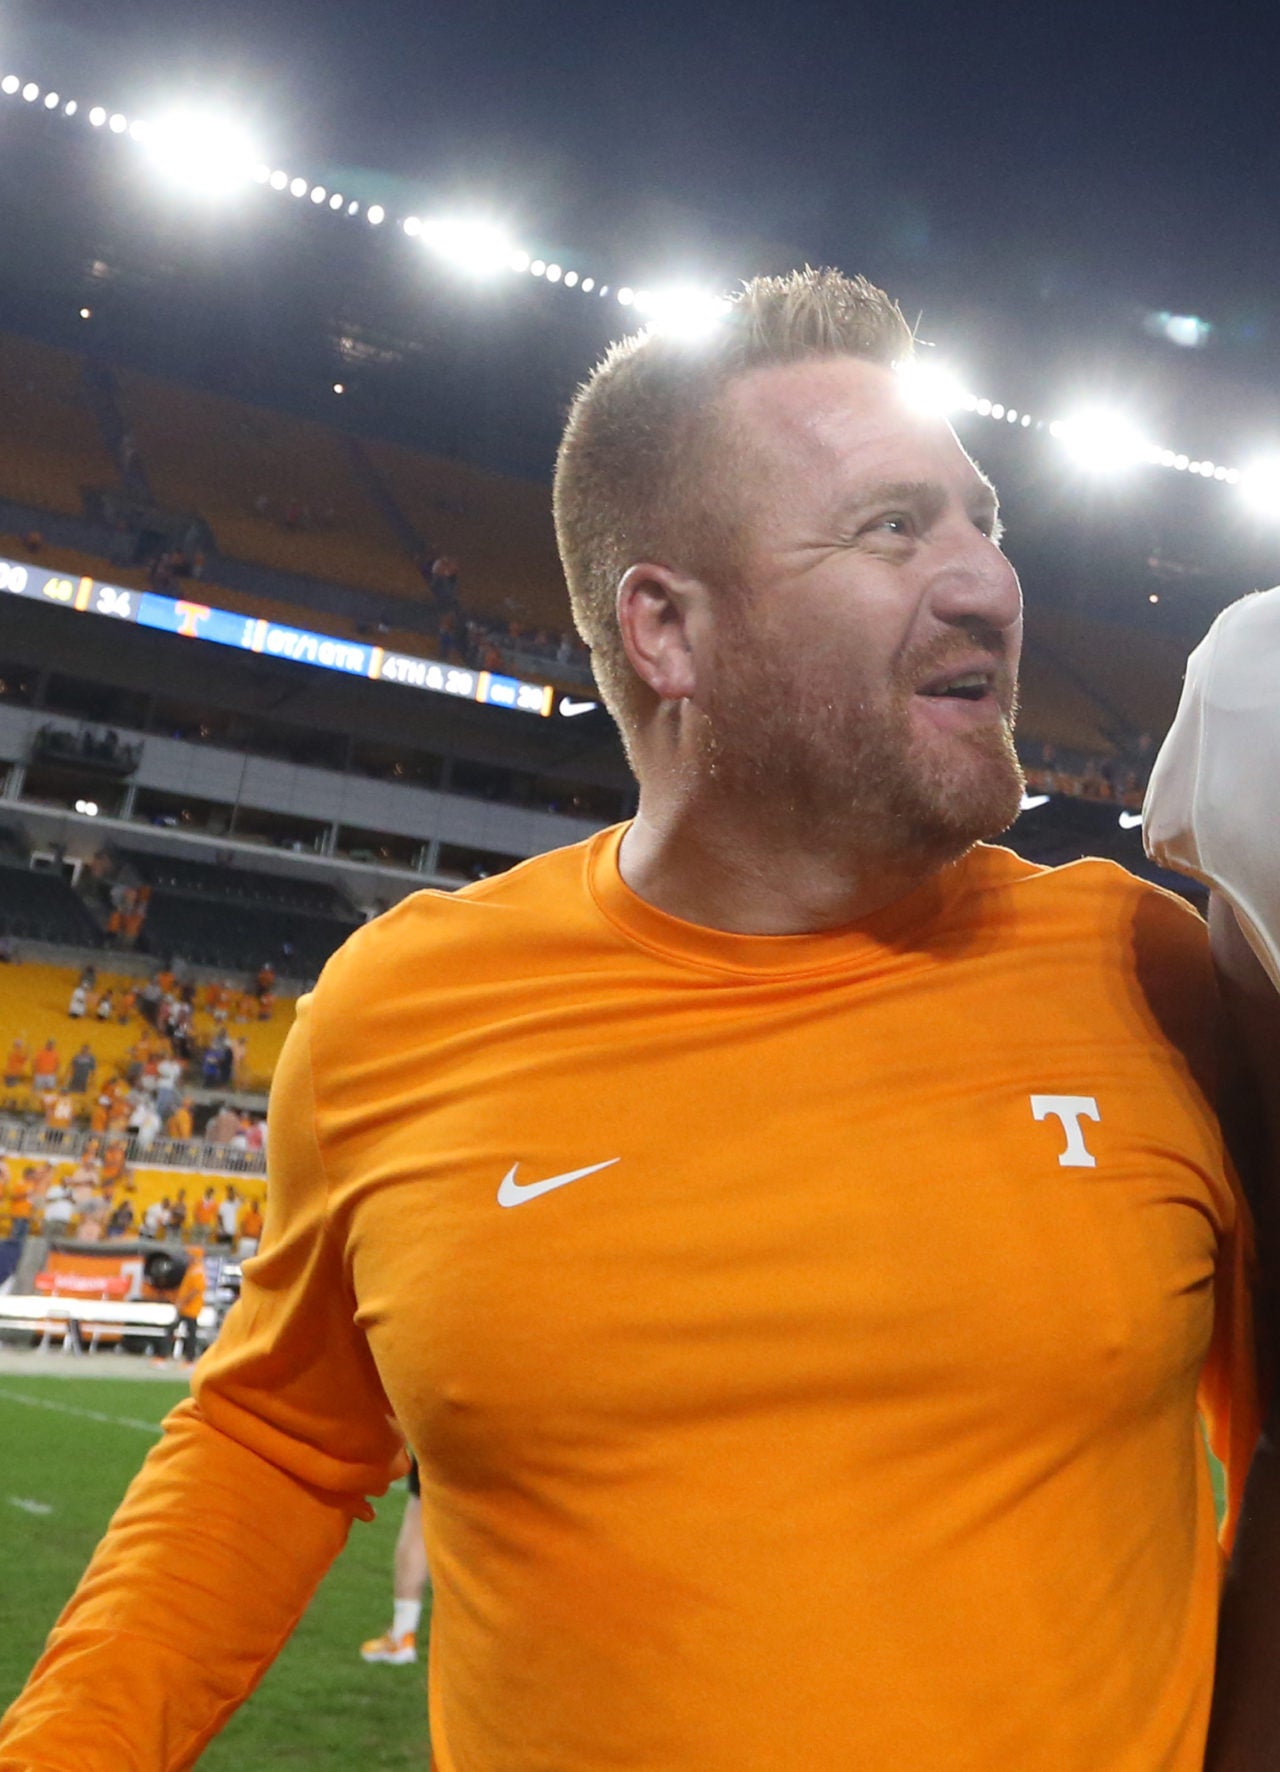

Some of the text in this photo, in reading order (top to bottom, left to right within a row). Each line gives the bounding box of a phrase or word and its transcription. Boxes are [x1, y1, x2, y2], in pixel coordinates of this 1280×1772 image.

[97, 586, 131, 618] 34
[382, 656, 425, 685] 4TH
[1029, 1094, 1101, 1168] T
